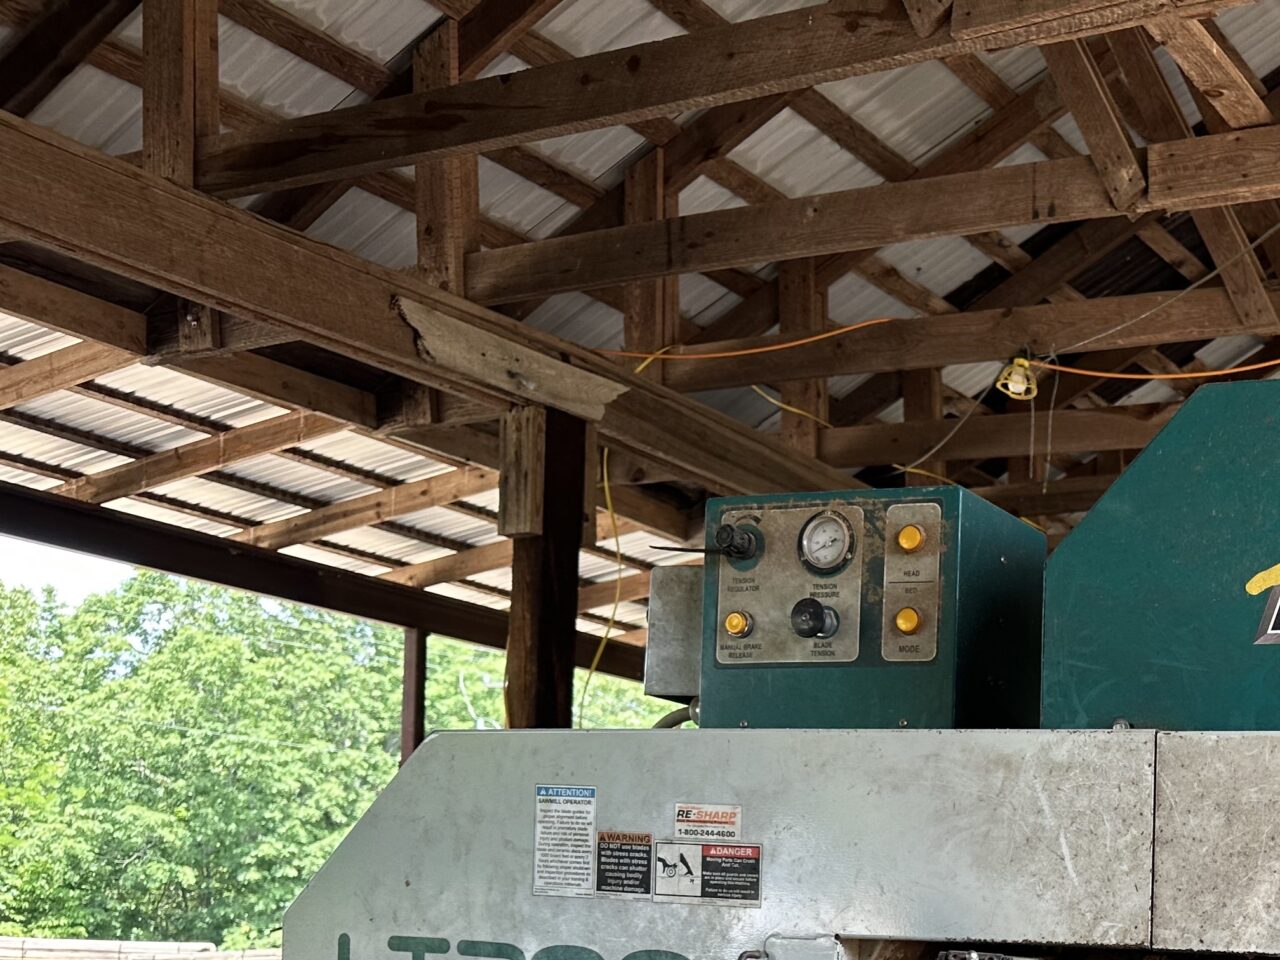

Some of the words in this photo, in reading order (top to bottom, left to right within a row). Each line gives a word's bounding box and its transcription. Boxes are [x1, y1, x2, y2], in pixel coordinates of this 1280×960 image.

[899, 645, 921, 653] MODE
[548, 788, 592, 796] ATTENTION!
[607, 833, 651, 843] WARNING
[716, 847, 752, 856] DANGER
